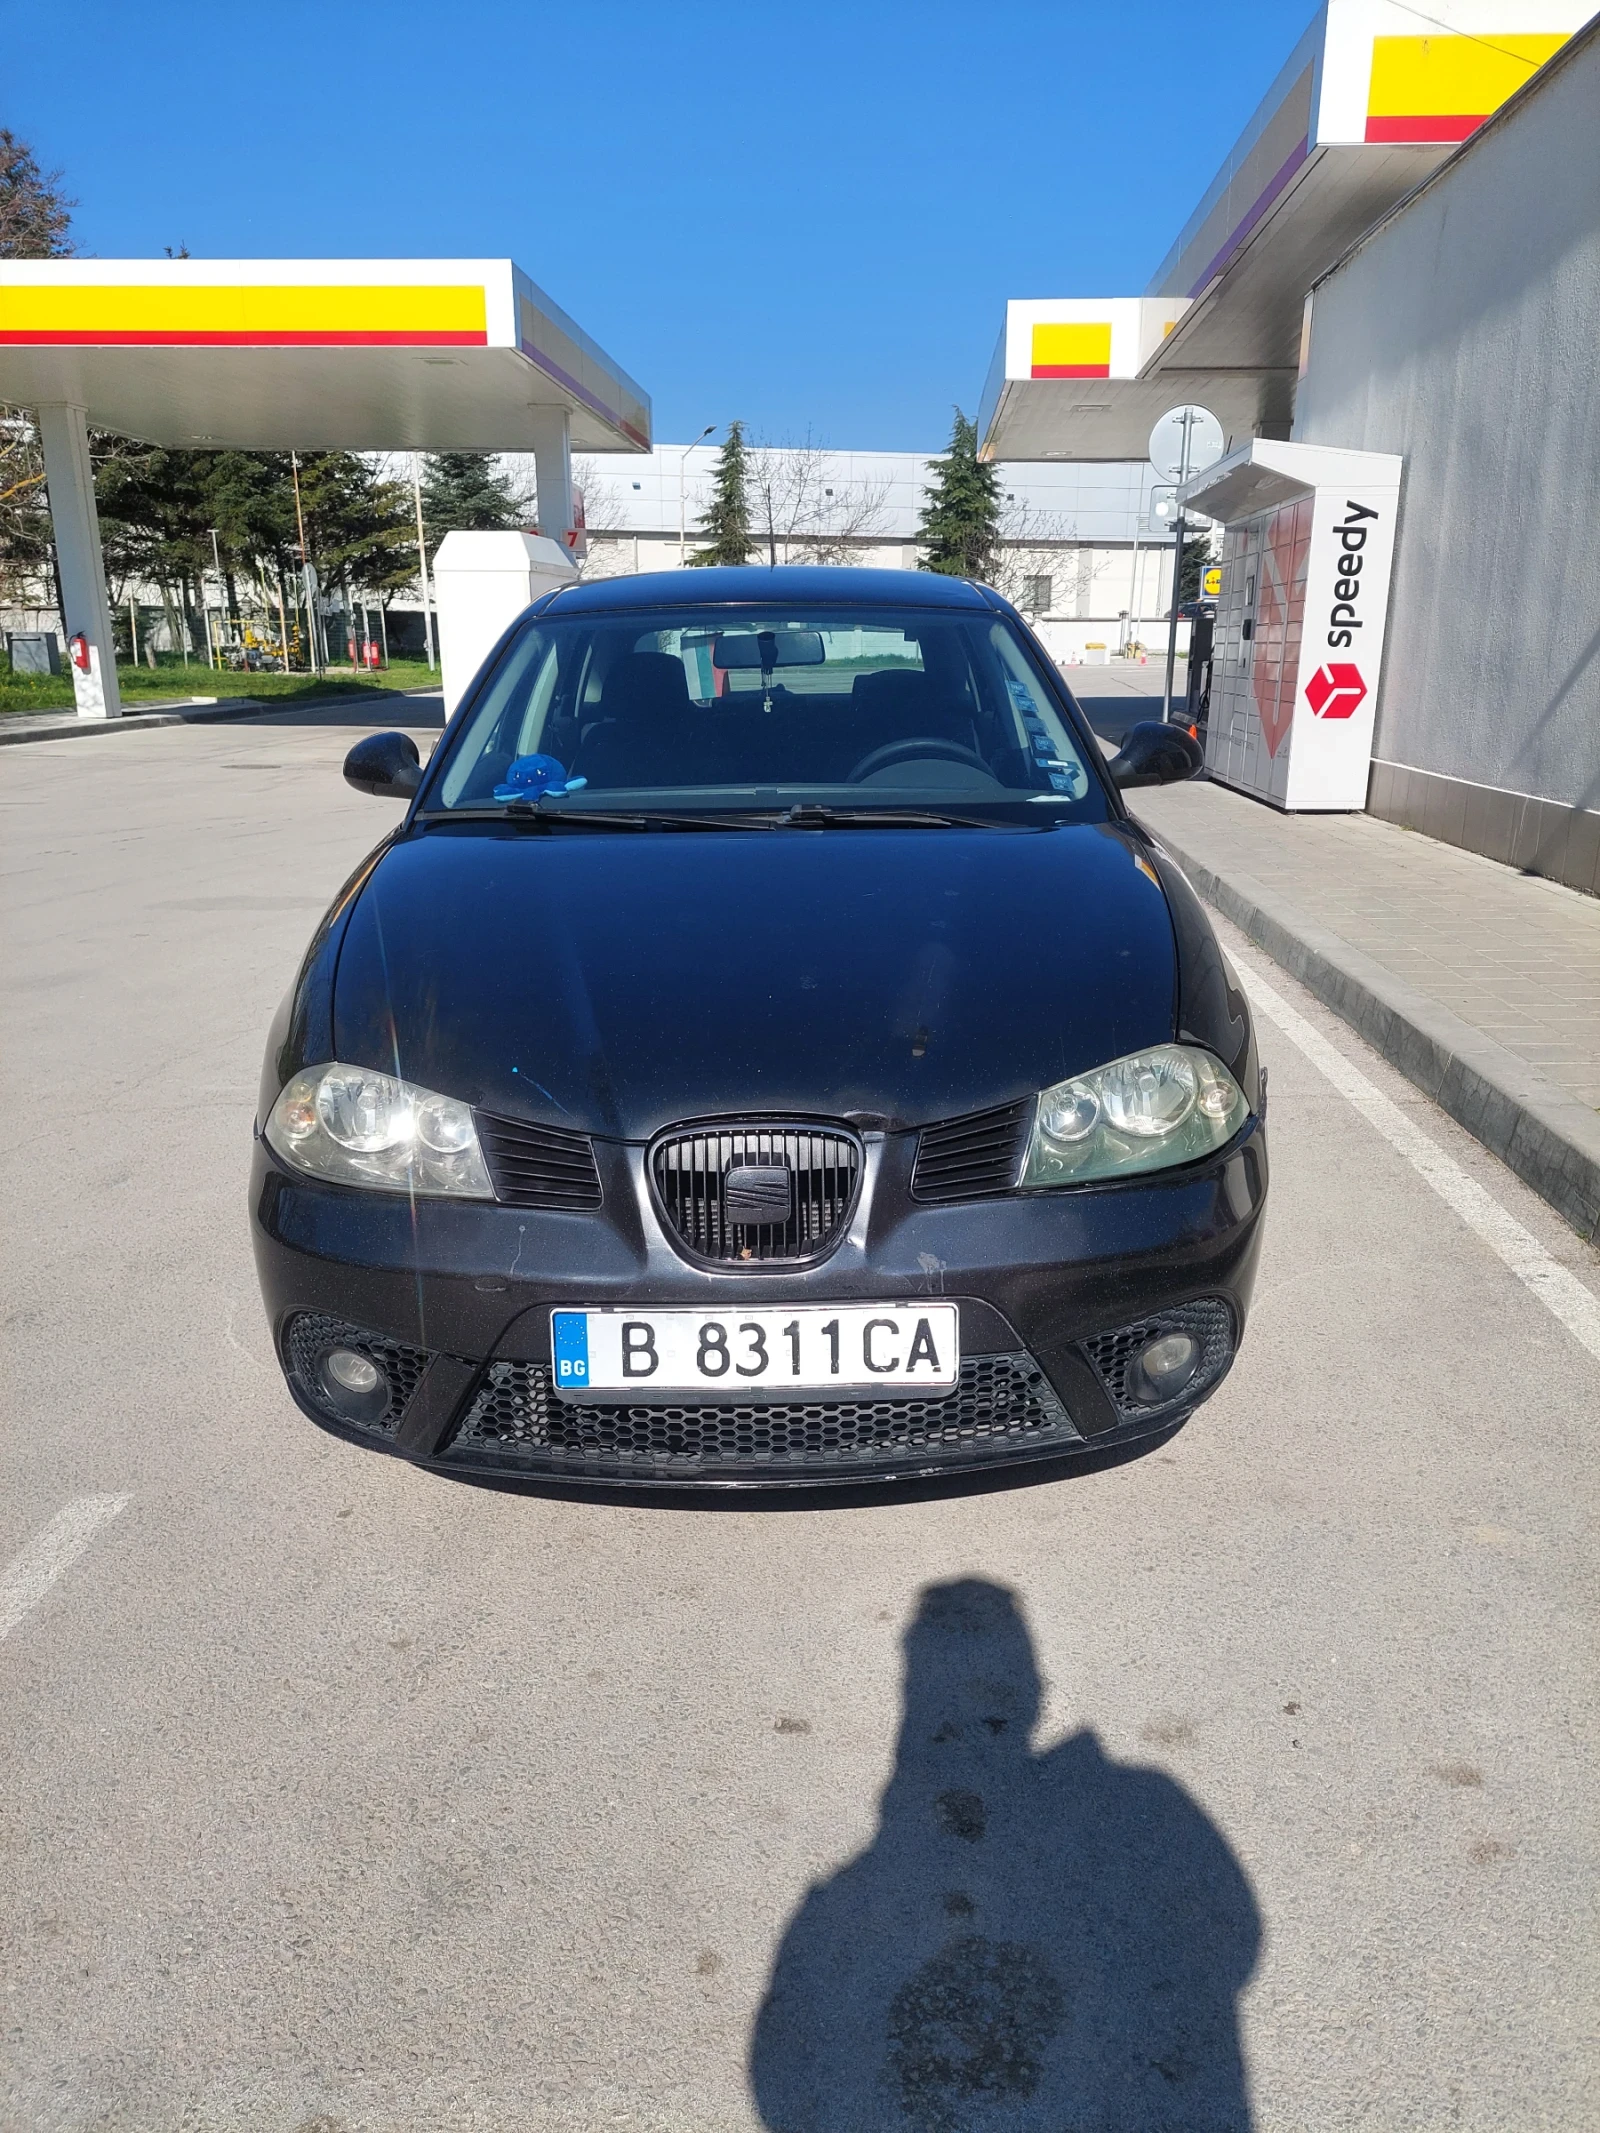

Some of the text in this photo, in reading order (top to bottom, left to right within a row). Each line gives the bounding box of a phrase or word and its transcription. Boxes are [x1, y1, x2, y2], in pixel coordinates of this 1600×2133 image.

[567, 531, 579, 548] 7
[1327, 500, 1379, 647] speedy
[622, 1321, 659, 1377] B
[560, 1359, 586, 1377] BG
